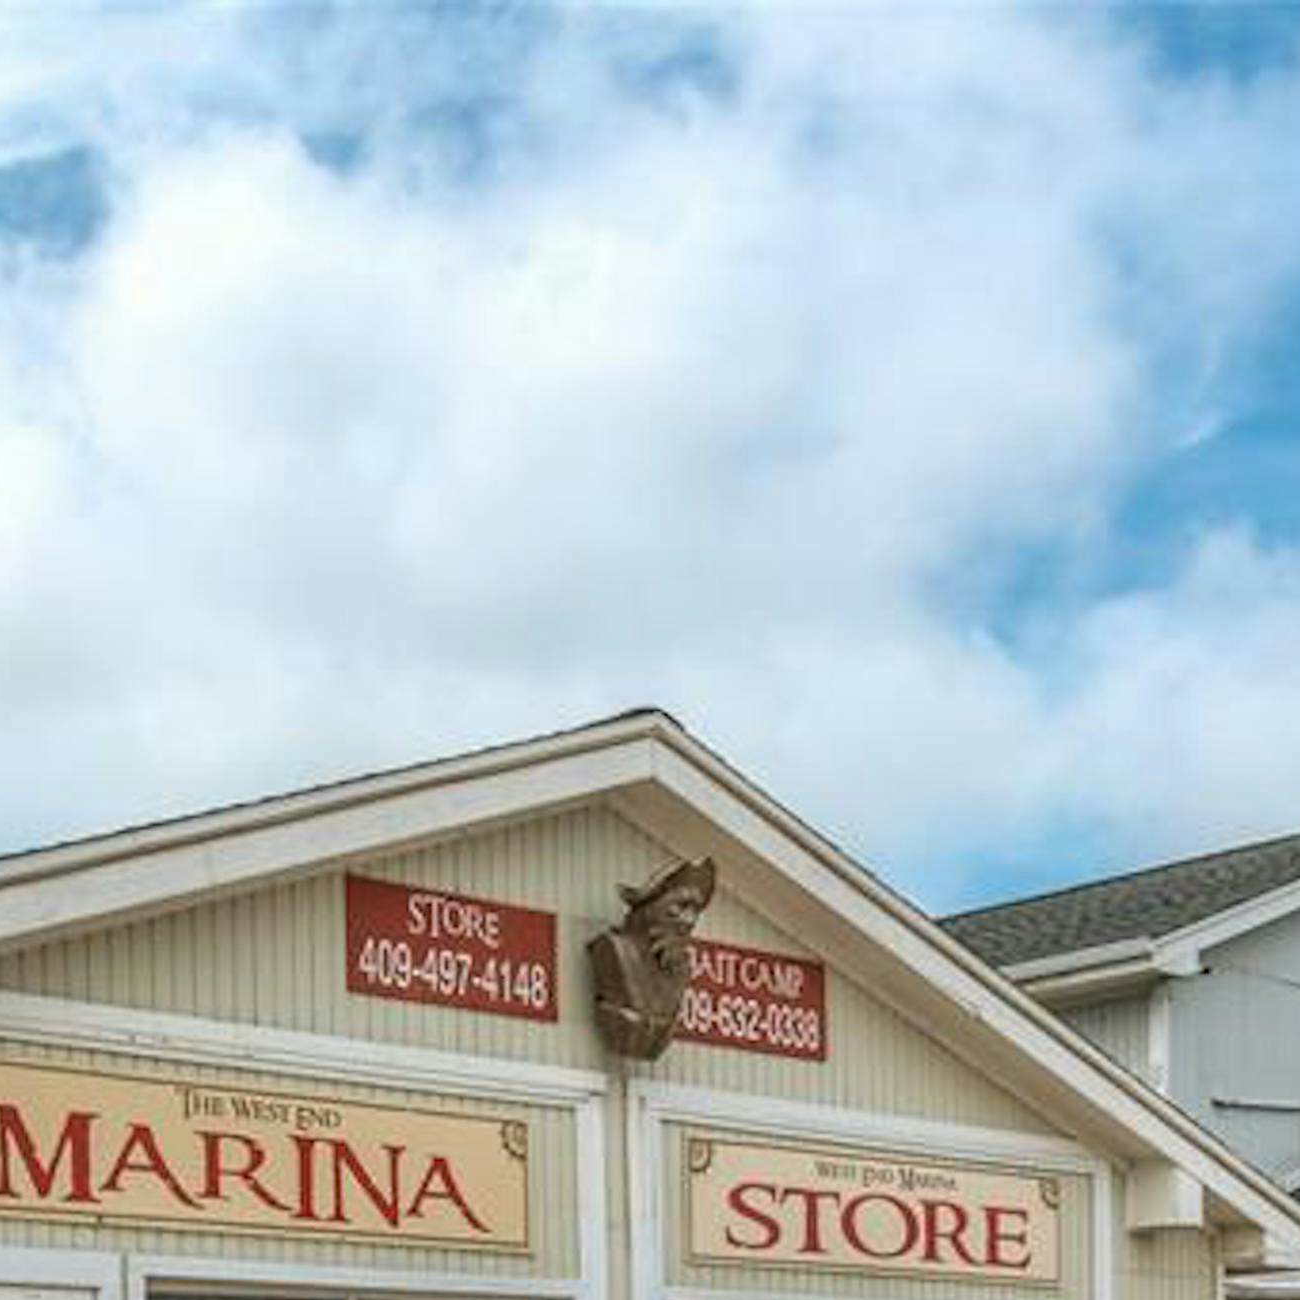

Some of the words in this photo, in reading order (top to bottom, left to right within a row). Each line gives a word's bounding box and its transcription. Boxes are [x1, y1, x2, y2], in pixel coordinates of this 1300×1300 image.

[407, 893, 501, 949] STORE
[357, 937, 548, 1009] 409-497-4148
[740, 957, 803, 999] CAMP
[181, 1088, 226, 1120] THE
[231, 1097, 289, 1123] WEST
[296, 1106, 343, 1131] END
[725, 1183, 1032, 1269] STORE
